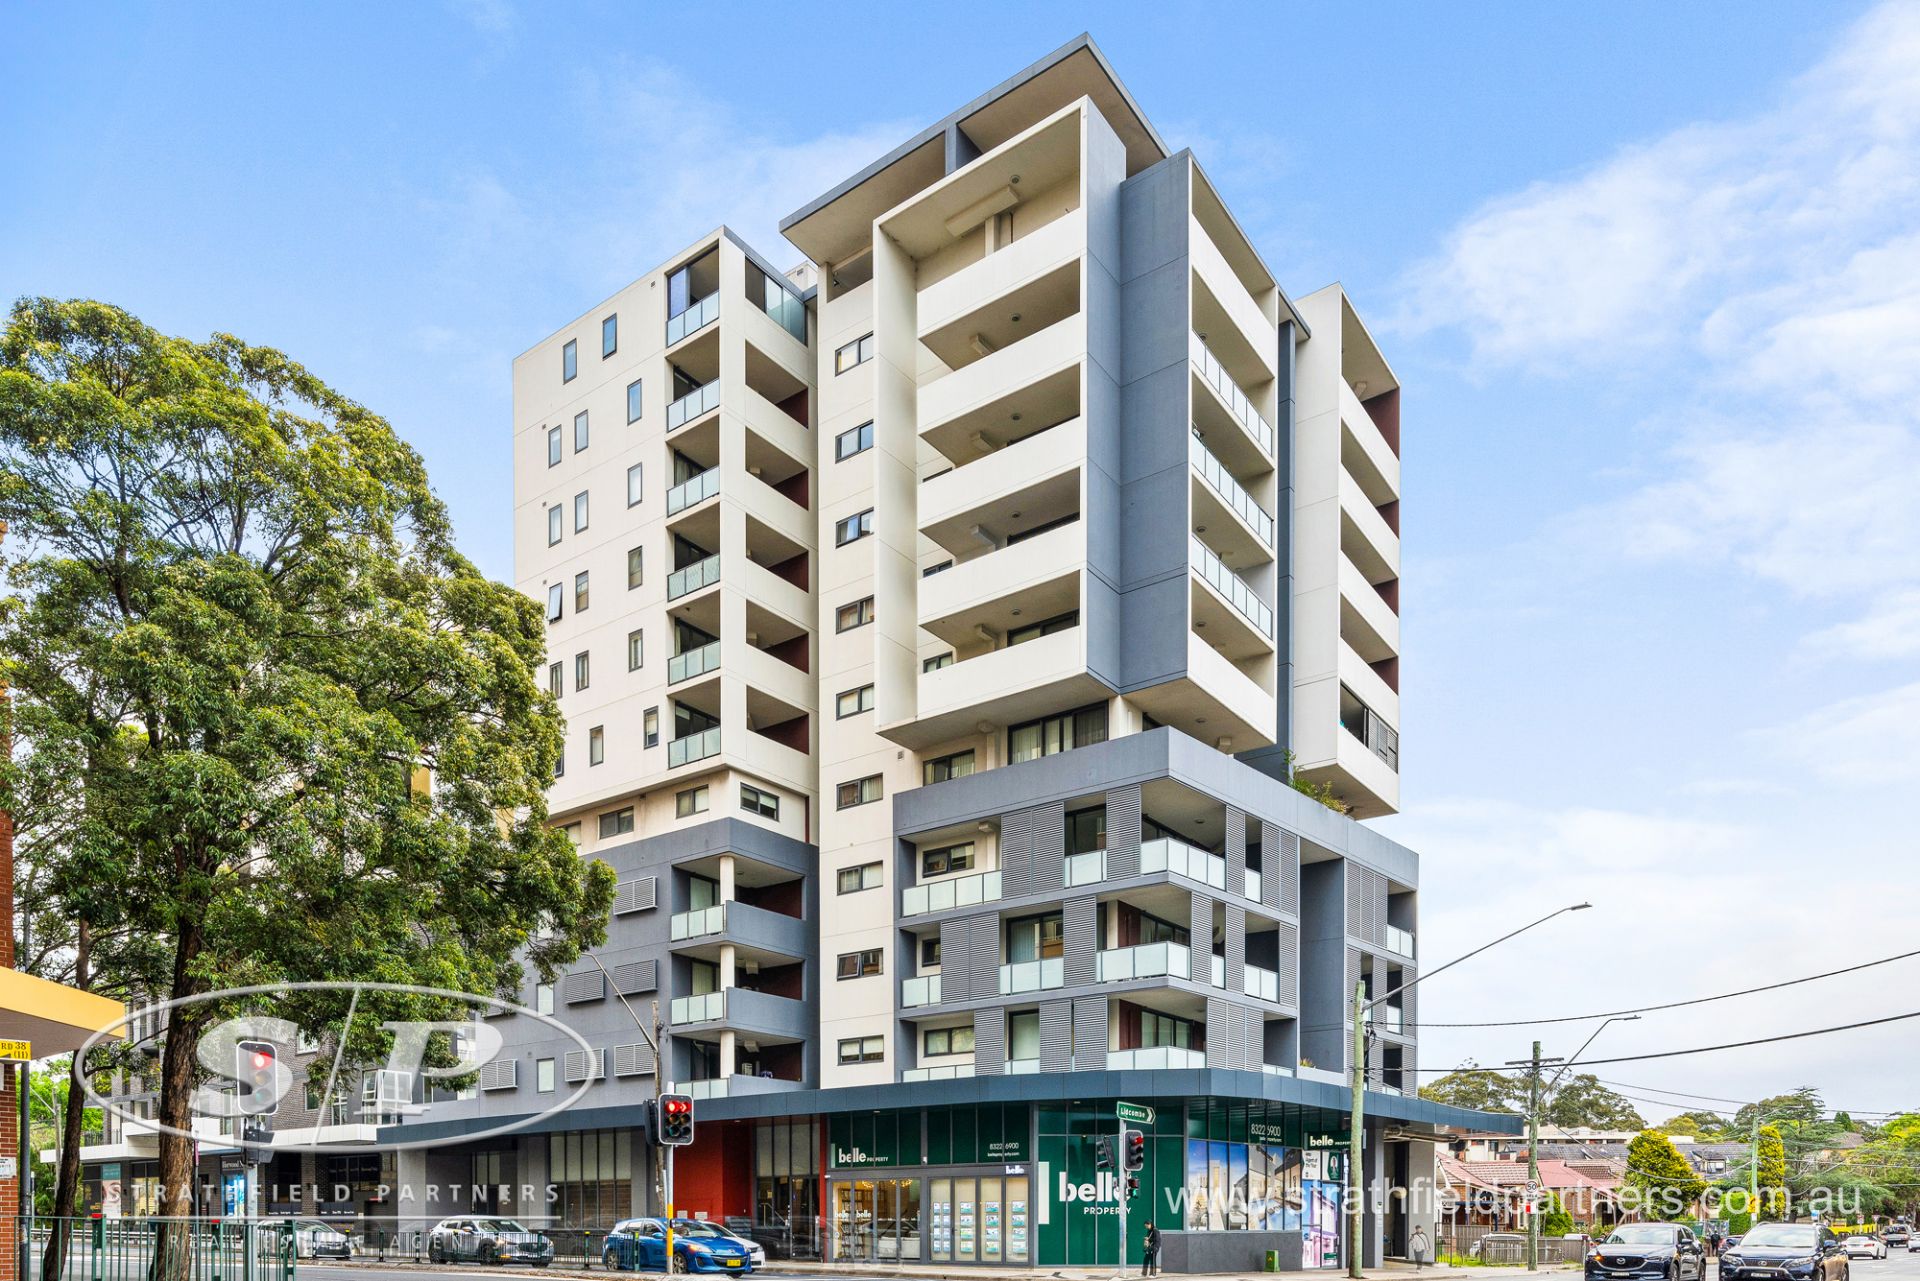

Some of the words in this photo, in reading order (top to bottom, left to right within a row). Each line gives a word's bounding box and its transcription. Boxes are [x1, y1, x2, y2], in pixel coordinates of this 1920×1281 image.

[15, 1042, 26, 1050] 38
[1120, 1107, 1146, 1118] Lidcombe
[1310, 1135, 1334, 1146] belle
[838, 1147, 866, 1163] belle
[1005, 1165, 1025, 1174] belle
[856, 1209, 872, 1217] belle
[1083, 1207, 1132, 1215] PROPERY
